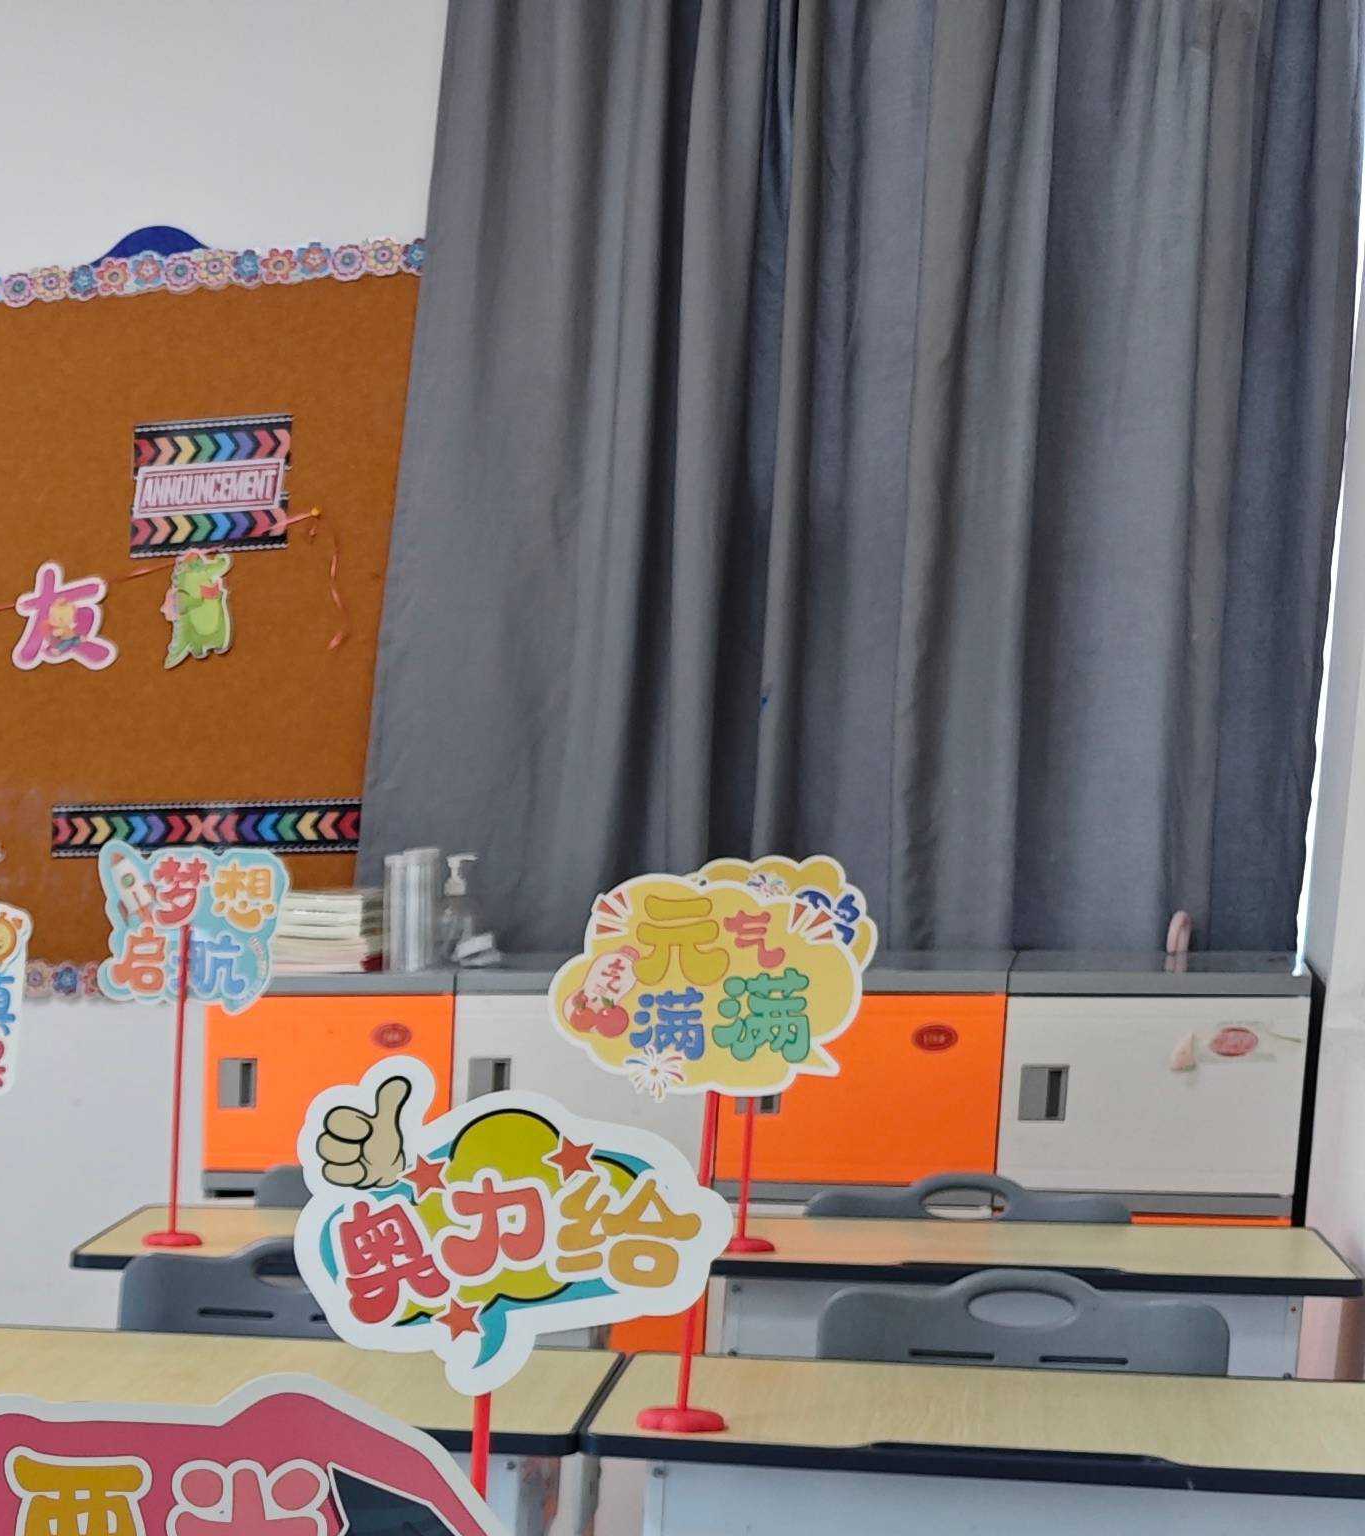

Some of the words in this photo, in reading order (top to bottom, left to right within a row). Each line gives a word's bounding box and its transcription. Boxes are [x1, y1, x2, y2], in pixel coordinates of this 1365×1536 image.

[141, 469, 278, 508] ANNOUNCEMENT
[154, 856, 275, 929] 梦想
[635, 893, 787, 986] 元气
[630, 968, 810, 1064] 满满
[339, 1175, 702, 1325] 奥力给
